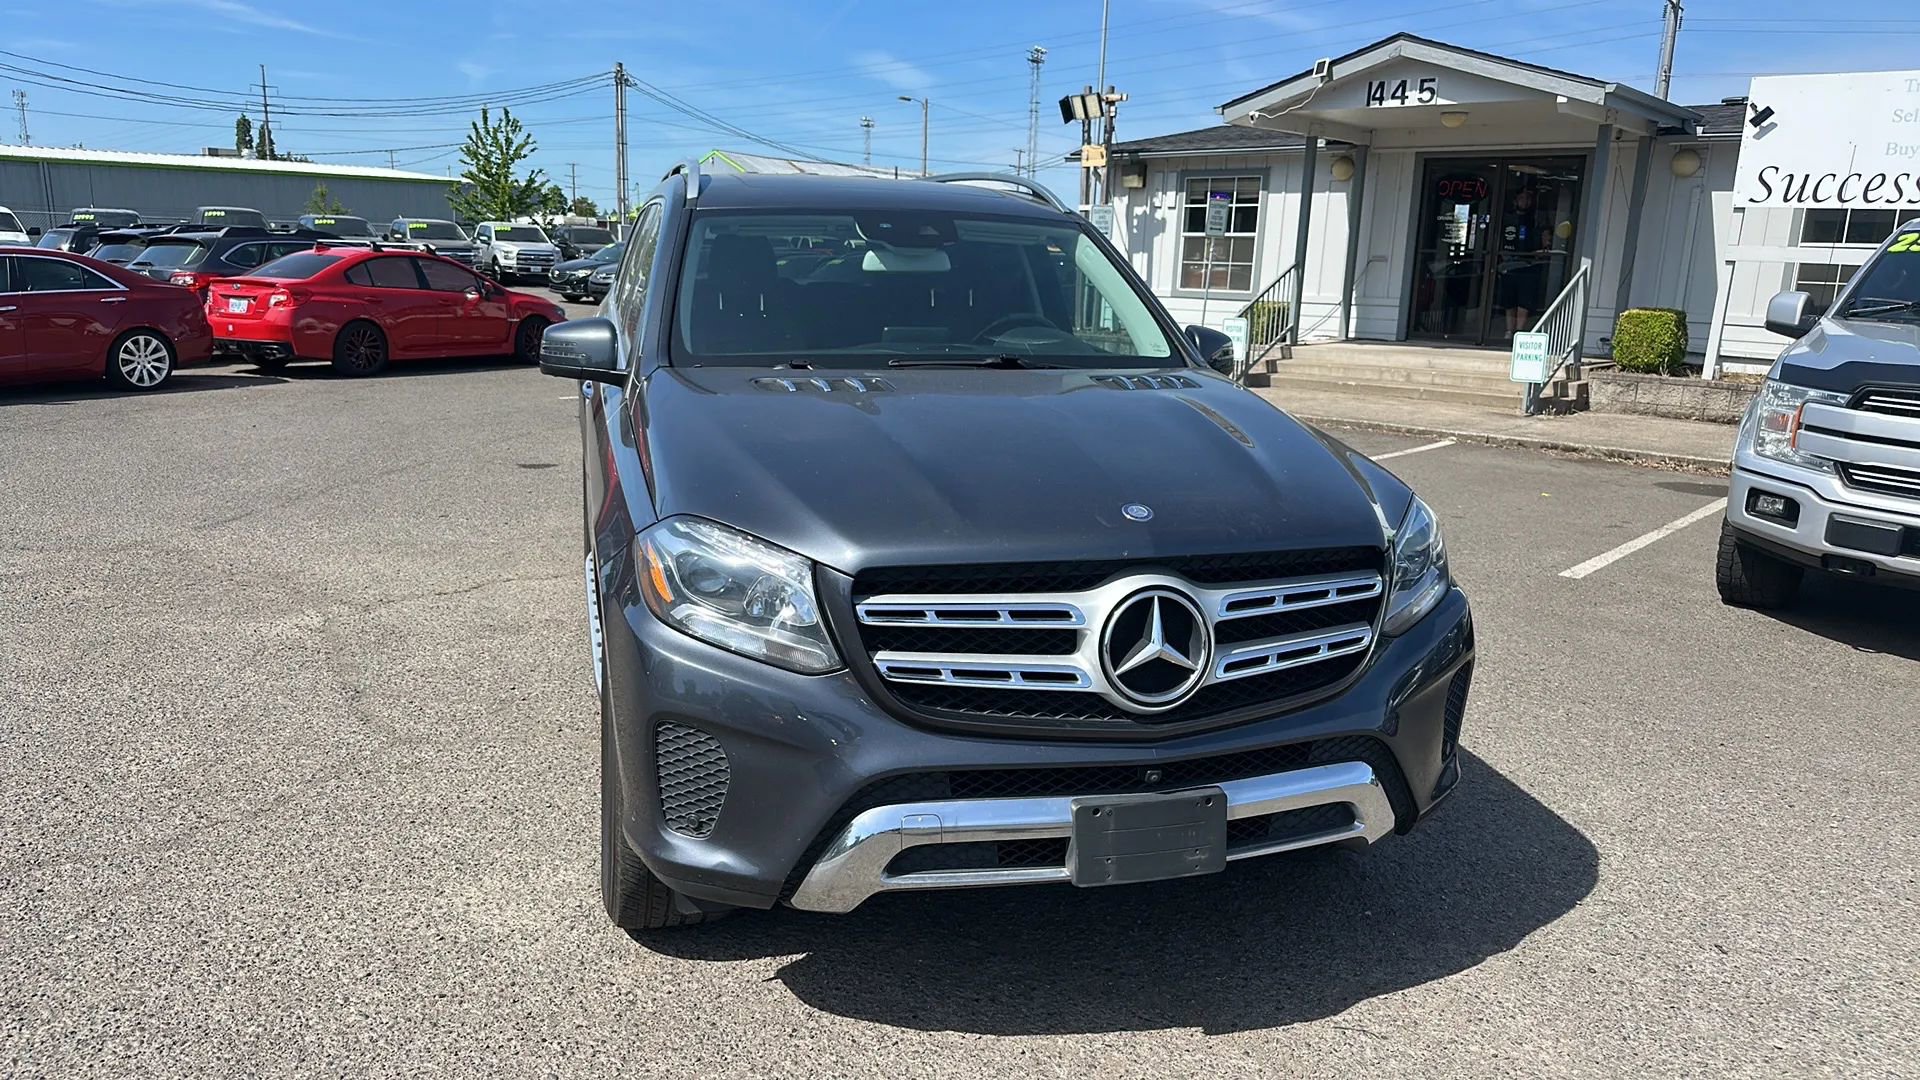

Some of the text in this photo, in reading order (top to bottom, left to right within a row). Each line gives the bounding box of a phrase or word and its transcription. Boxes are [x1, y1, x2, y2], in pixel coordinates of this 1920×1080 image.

[1366, 78, 1437, 107] 1445
[1439, 178, 1488, 199] OPEN
[1519, 341, 1543, 350] VISITOR
[1516, 352, 1543, 361] PARKING
